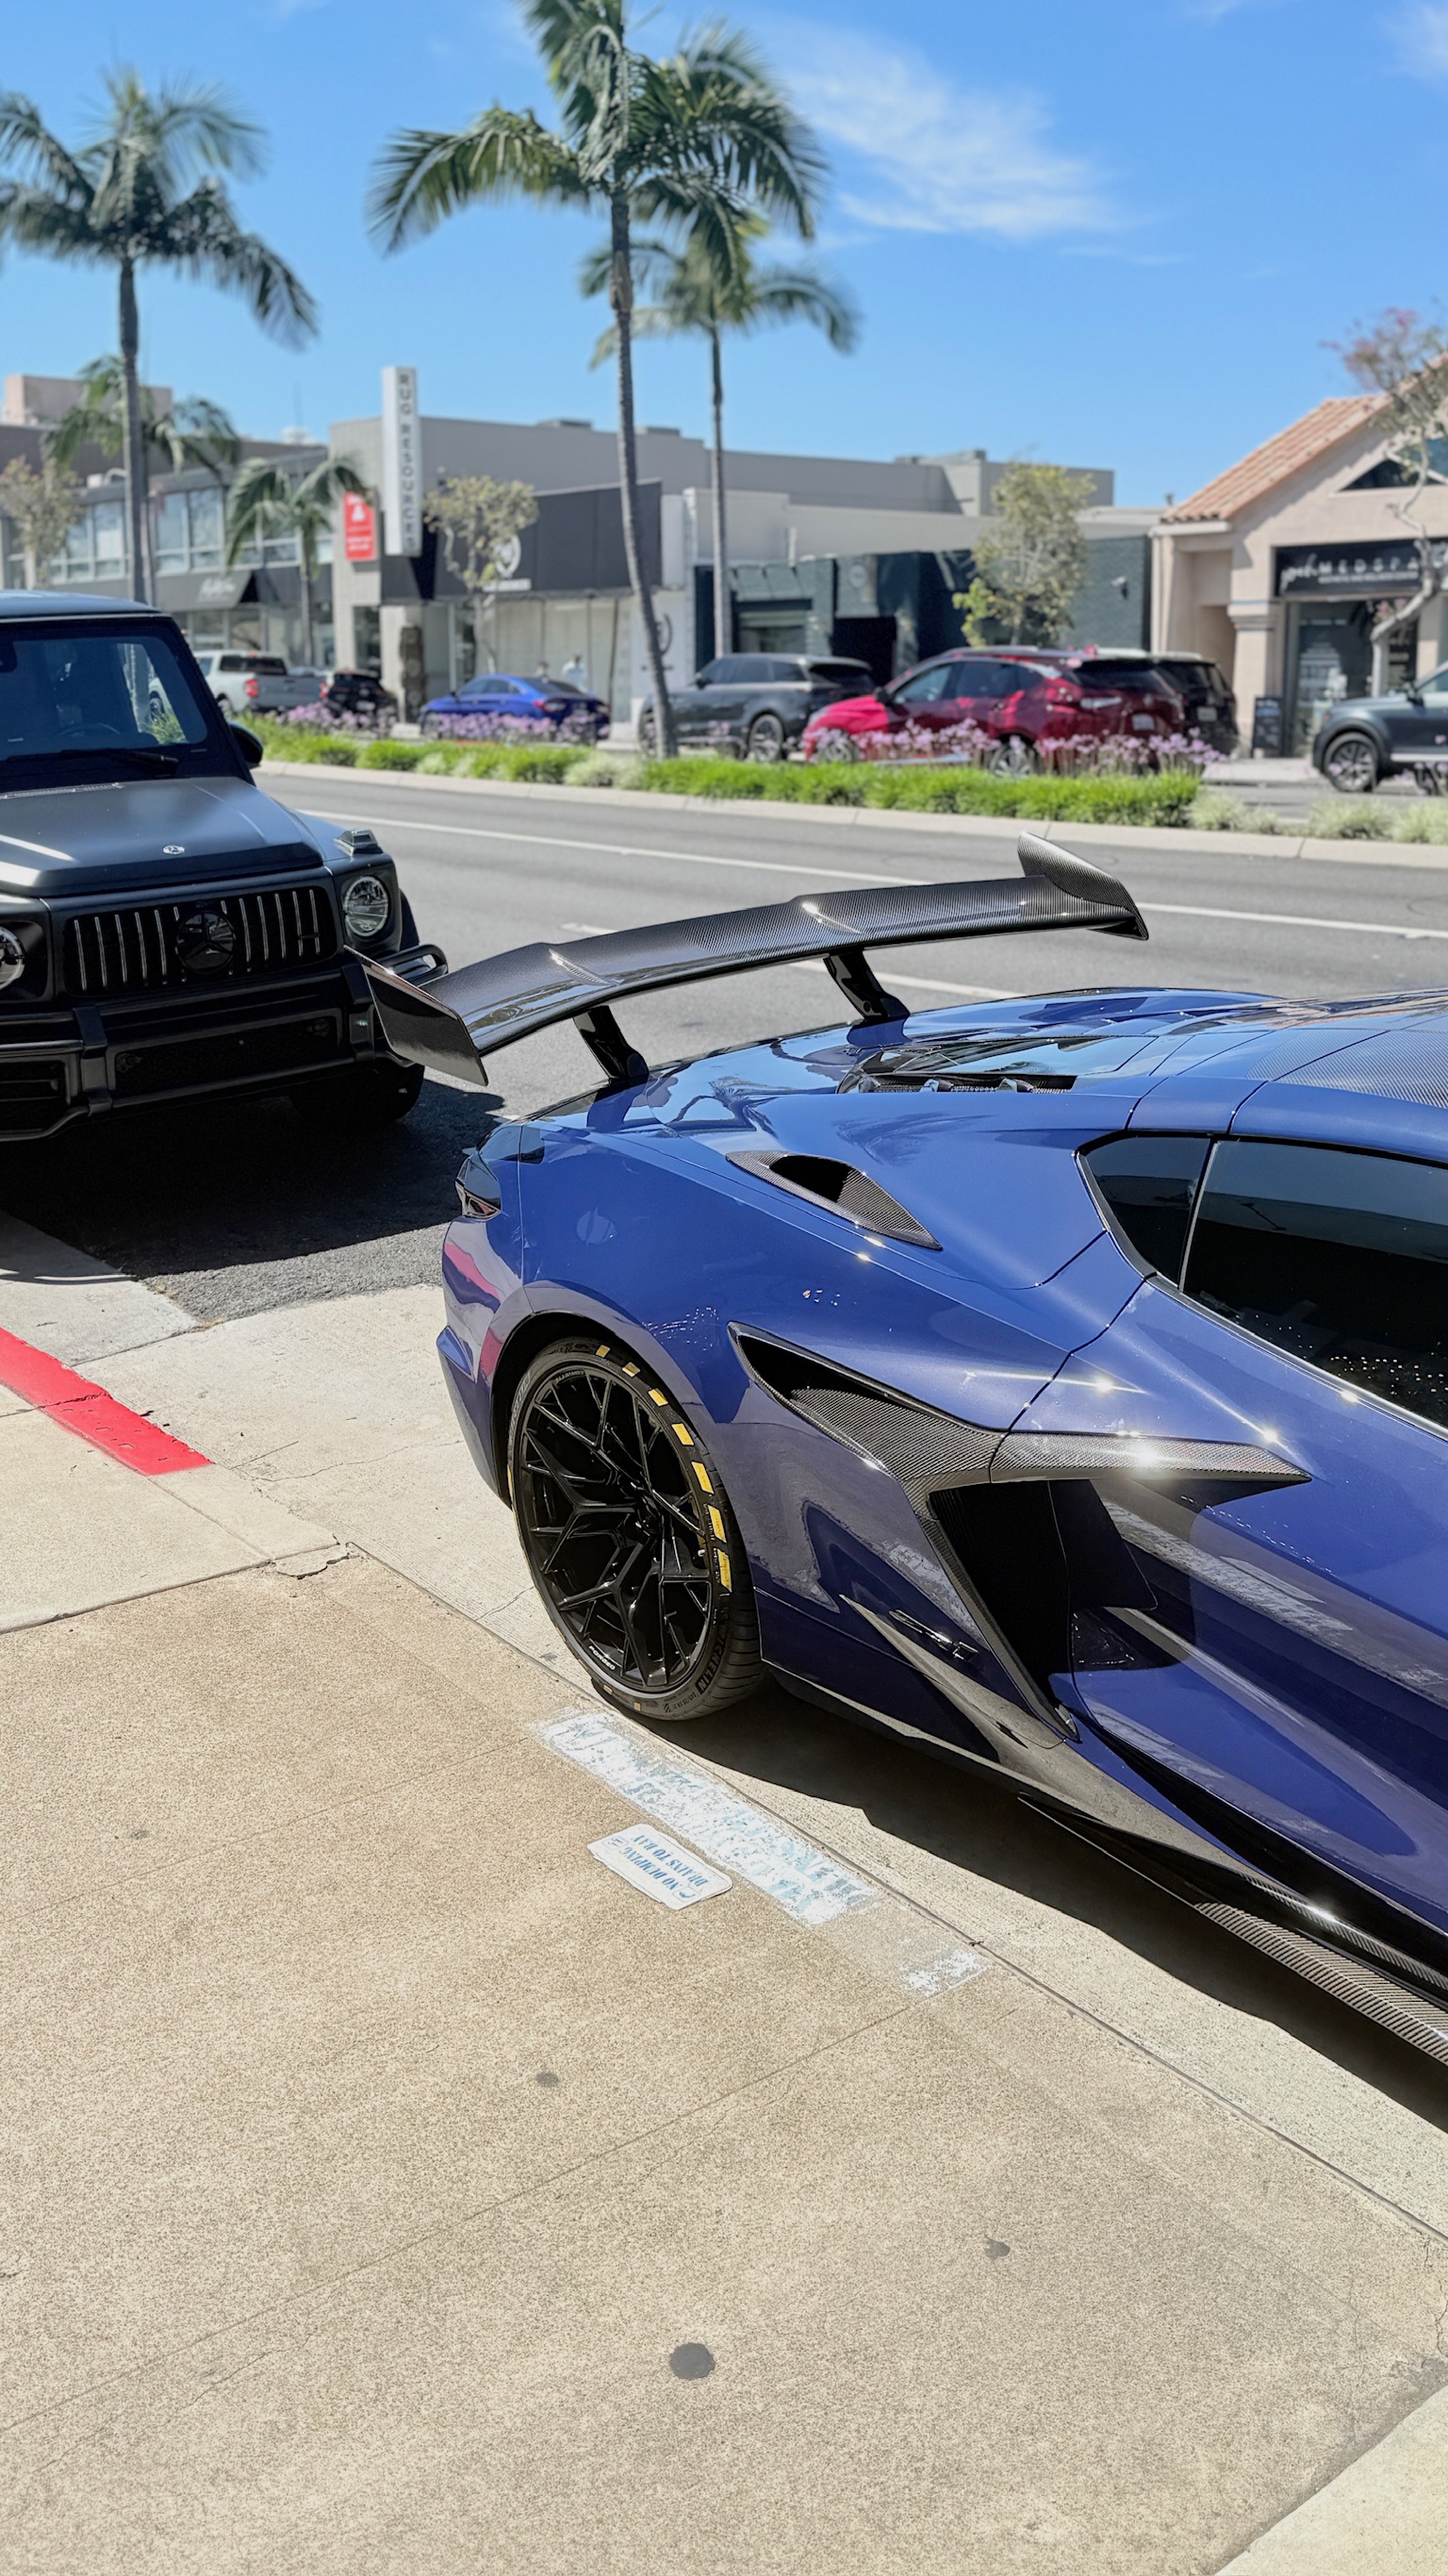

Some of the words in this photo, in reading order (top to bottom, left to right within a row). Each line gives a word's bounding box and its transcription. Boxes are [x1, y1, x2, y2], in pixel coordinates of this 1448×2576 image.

[399, 372, 412, 416] RUG
[401, 424, 416, 549] RESOURCES
[588, 1645, 616, 1671] FORGED
[631, 1834, 659, 1851] BAY
[651, 1849, 673, 1862] TO
[620, 1846, 667, 1879] DUMPING
[666, 1858, 709, 1887] DRAINS
[662, 1877, 683, 1891] NO
